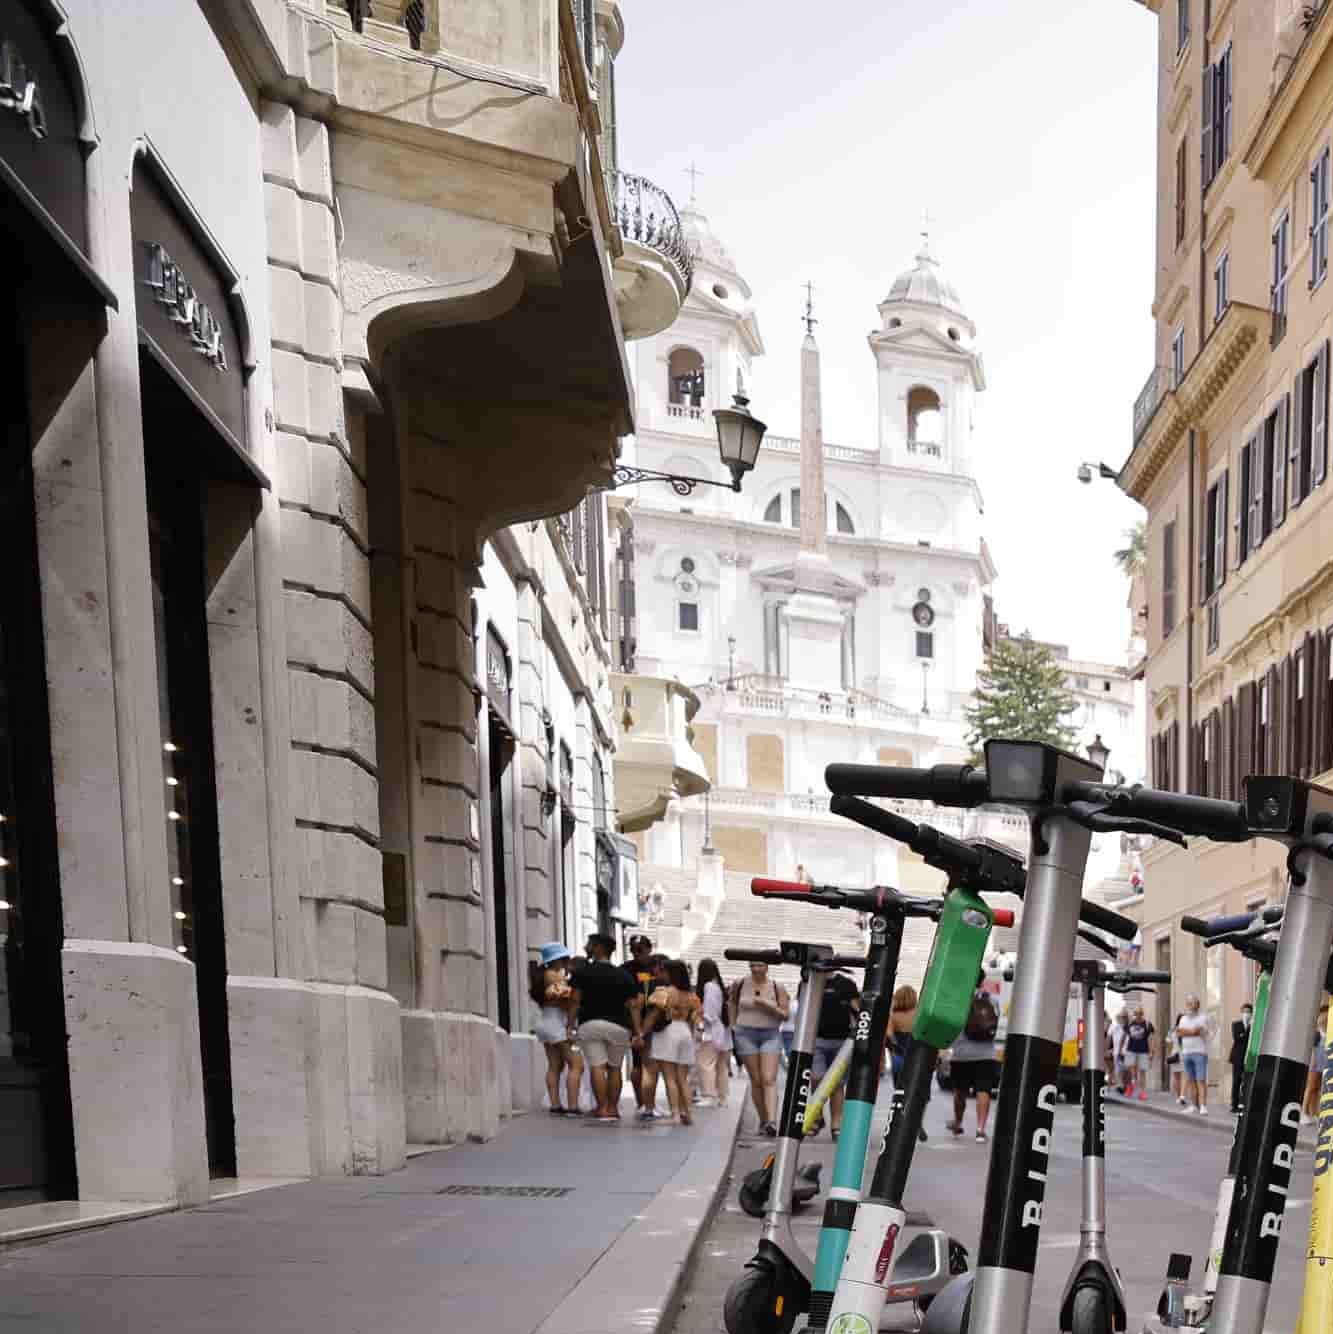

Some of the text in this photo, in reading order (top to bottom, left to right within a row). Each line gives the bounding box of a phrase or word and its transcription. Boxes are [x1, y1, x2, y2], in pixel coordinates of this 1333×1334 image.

[855, 1010, 872, 1041] dott
[1021, 1084, 1058, 1229] BIRD
[1259, 1101, 1302, 1239] BIRD
